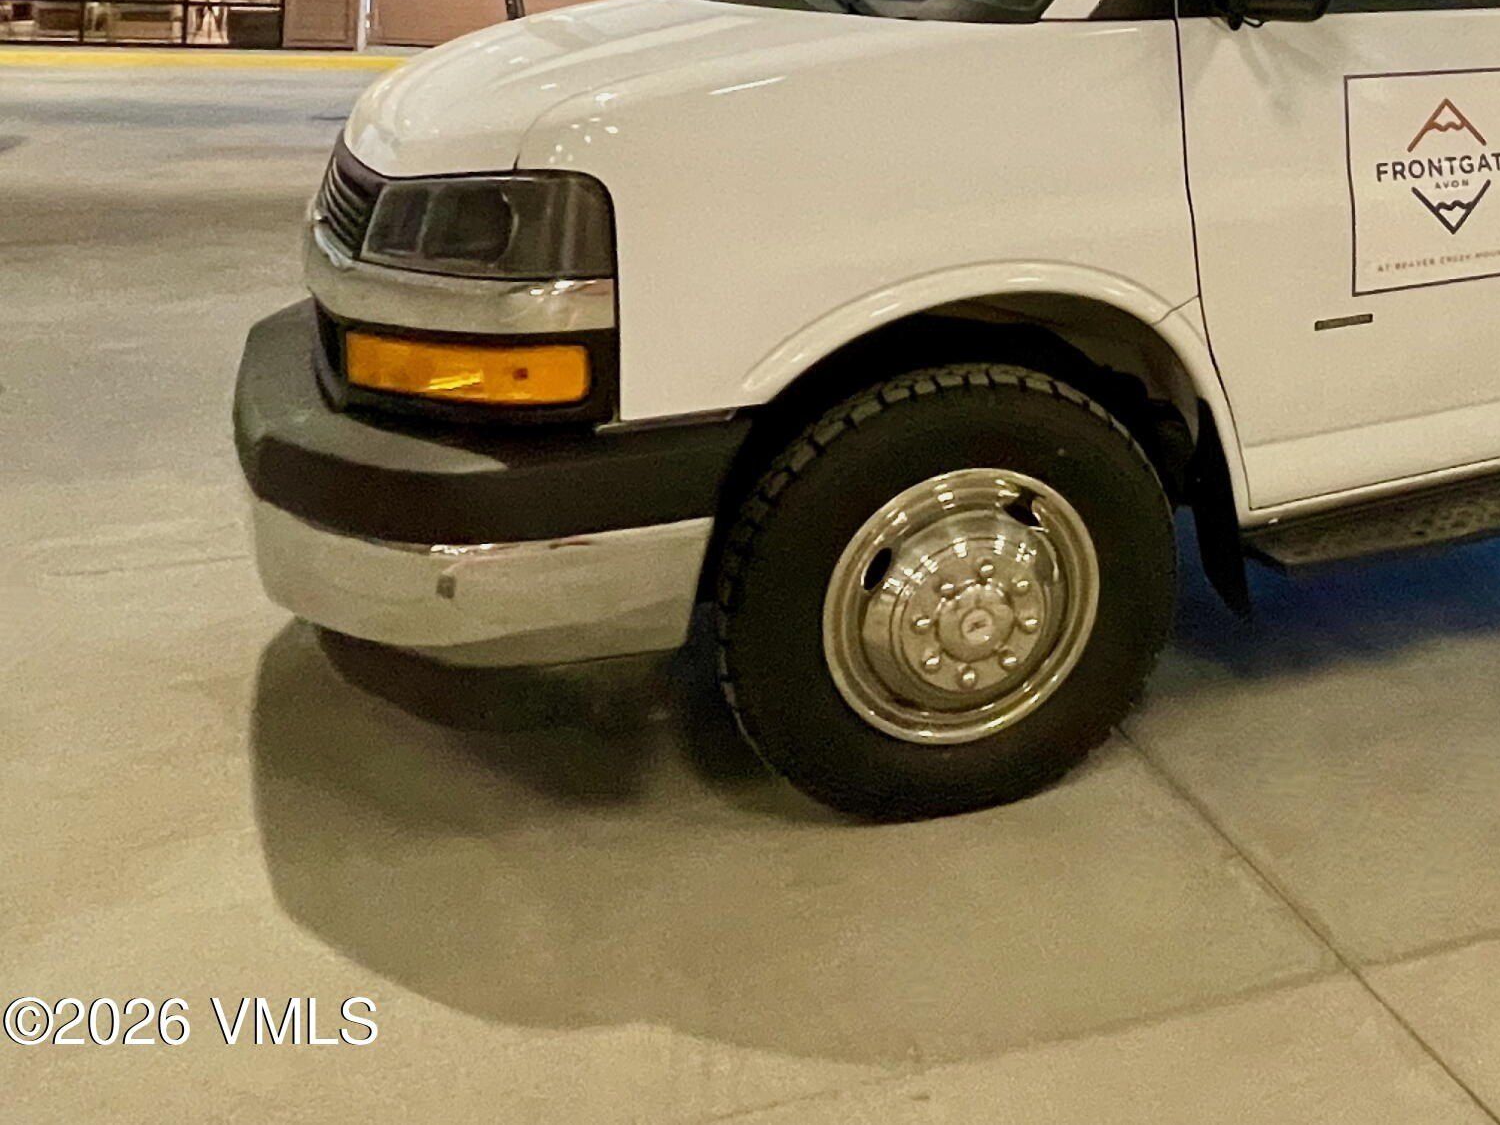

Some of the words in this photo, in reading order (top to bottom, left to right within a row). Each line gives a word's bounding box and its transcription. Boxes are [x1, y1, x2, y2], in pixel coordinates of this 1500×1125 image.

[1434, 178, 1470, 190] AVON
[1377, 264, 1391, 273] AT
[1394, 258, 1436, 271] BEAVER
